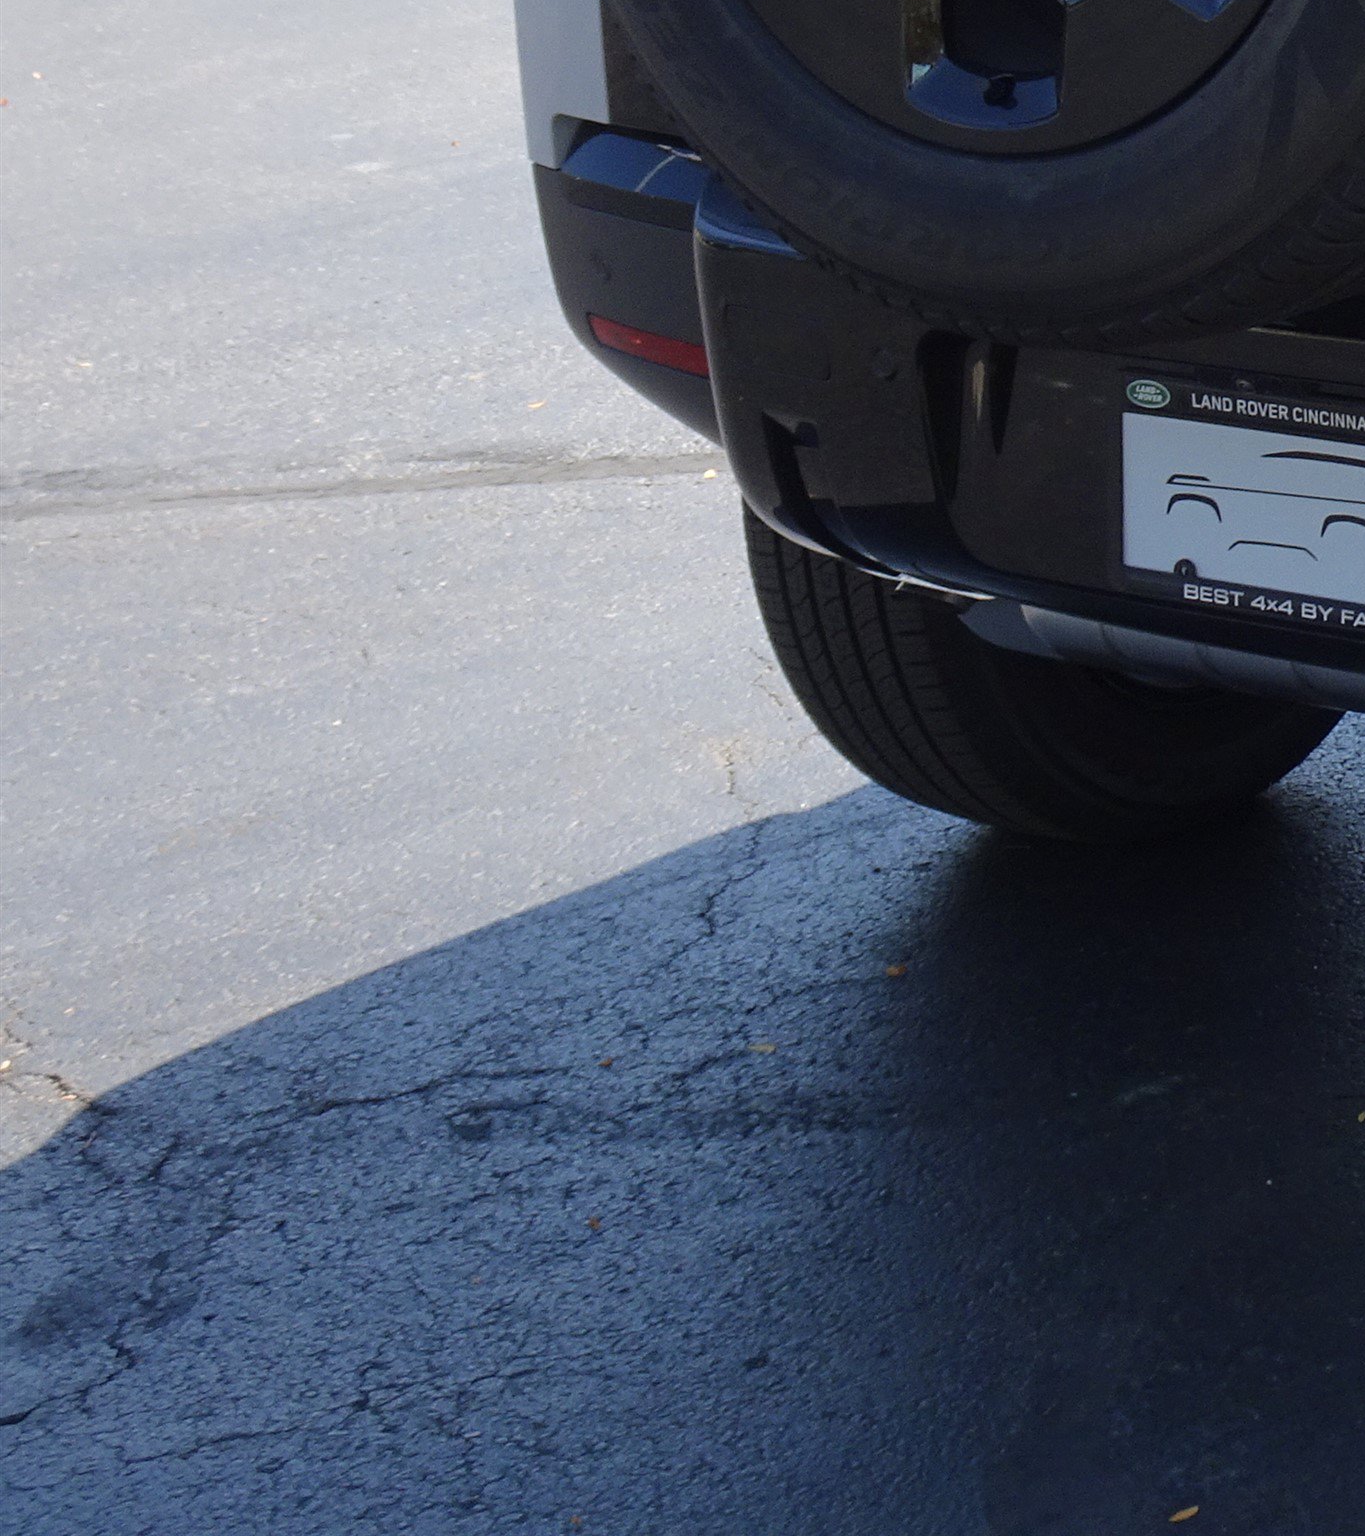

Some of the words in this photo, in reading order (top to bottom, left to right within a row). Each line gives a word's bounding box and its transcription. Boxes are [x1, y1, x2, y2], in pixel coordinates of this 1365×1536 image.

[1191, 393, 1233, 412] LAND
[1236, 399, 1289, 421] ROVER
[1183, 583, 1245, 607] BEST
[1250, 595, 1294, 616] 4x4
[1301, 602, 1334, 622] BY
